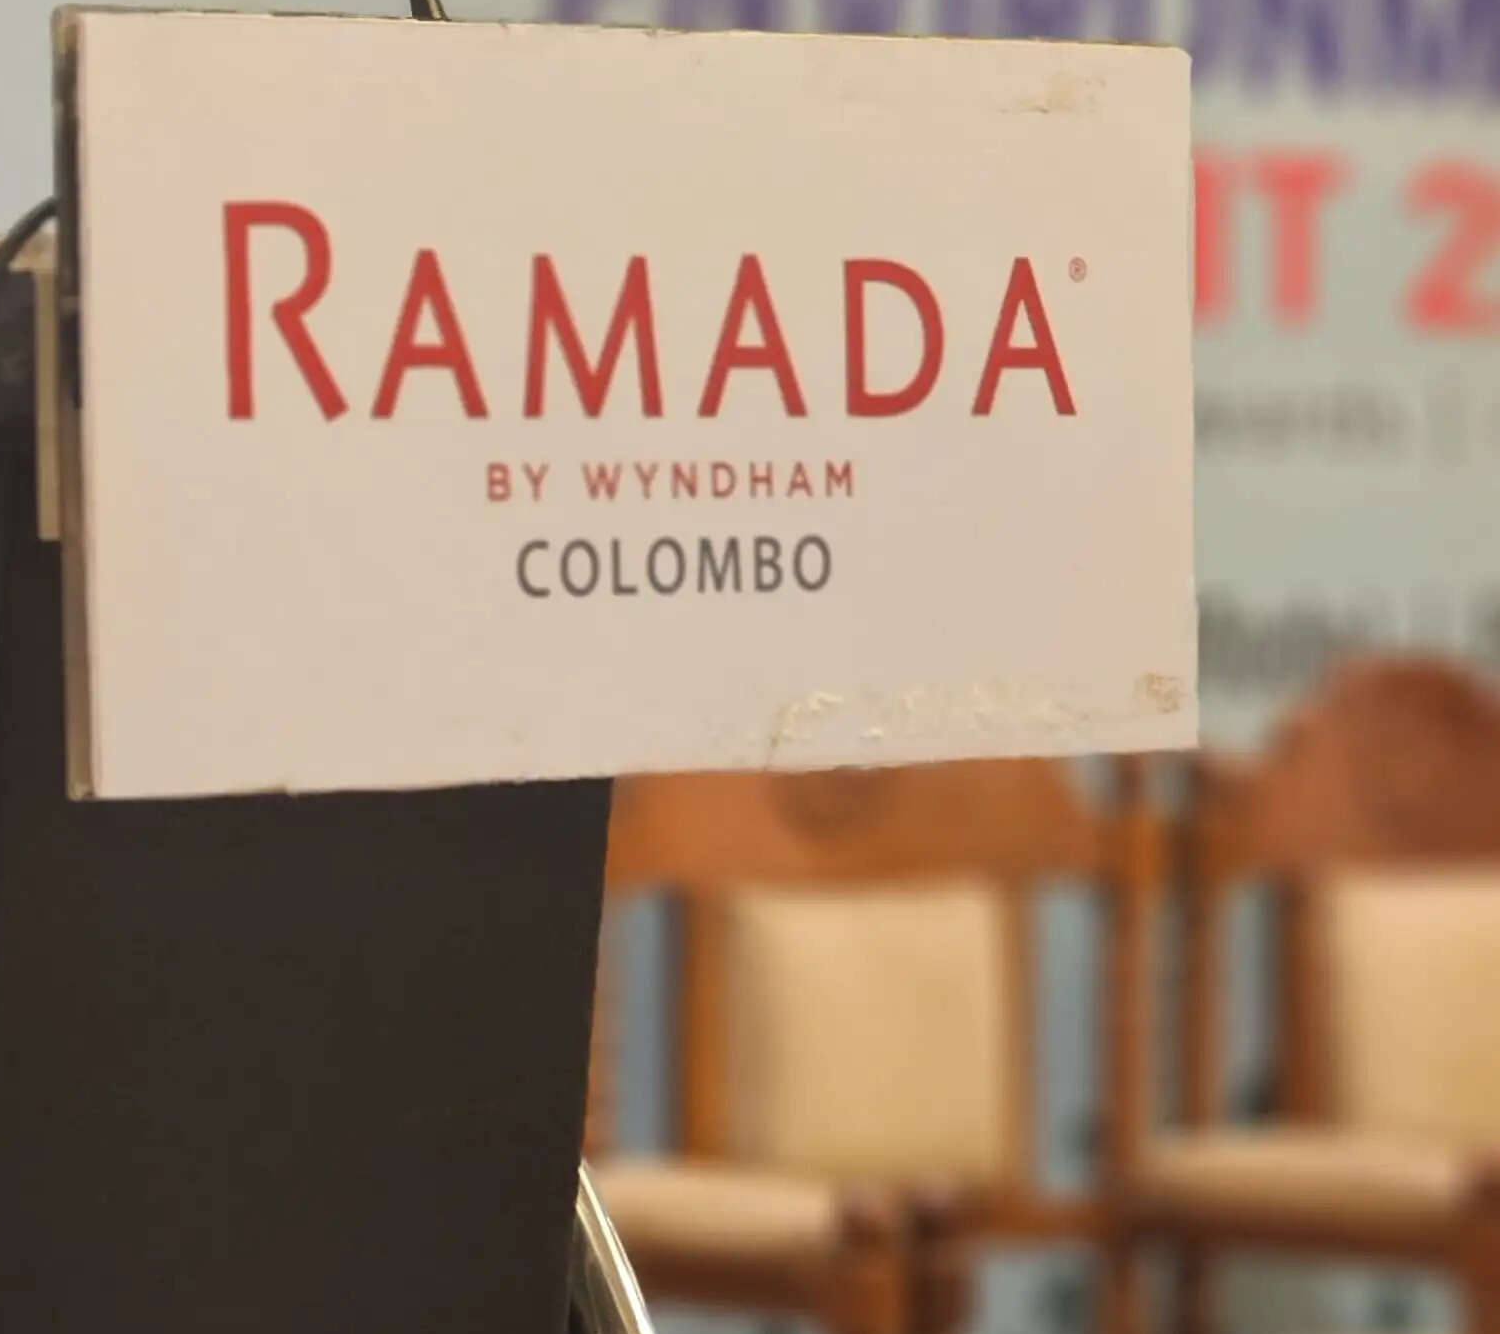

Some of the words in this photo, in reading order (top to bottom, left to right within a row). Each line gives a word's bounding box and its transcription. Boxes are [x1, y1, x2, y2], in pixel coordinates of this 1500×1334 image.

[487, 464, 549, 503] BY
[583, 462, 854, 500] WYNDHAM
[516, 535, 832, 598] COLOMBO
